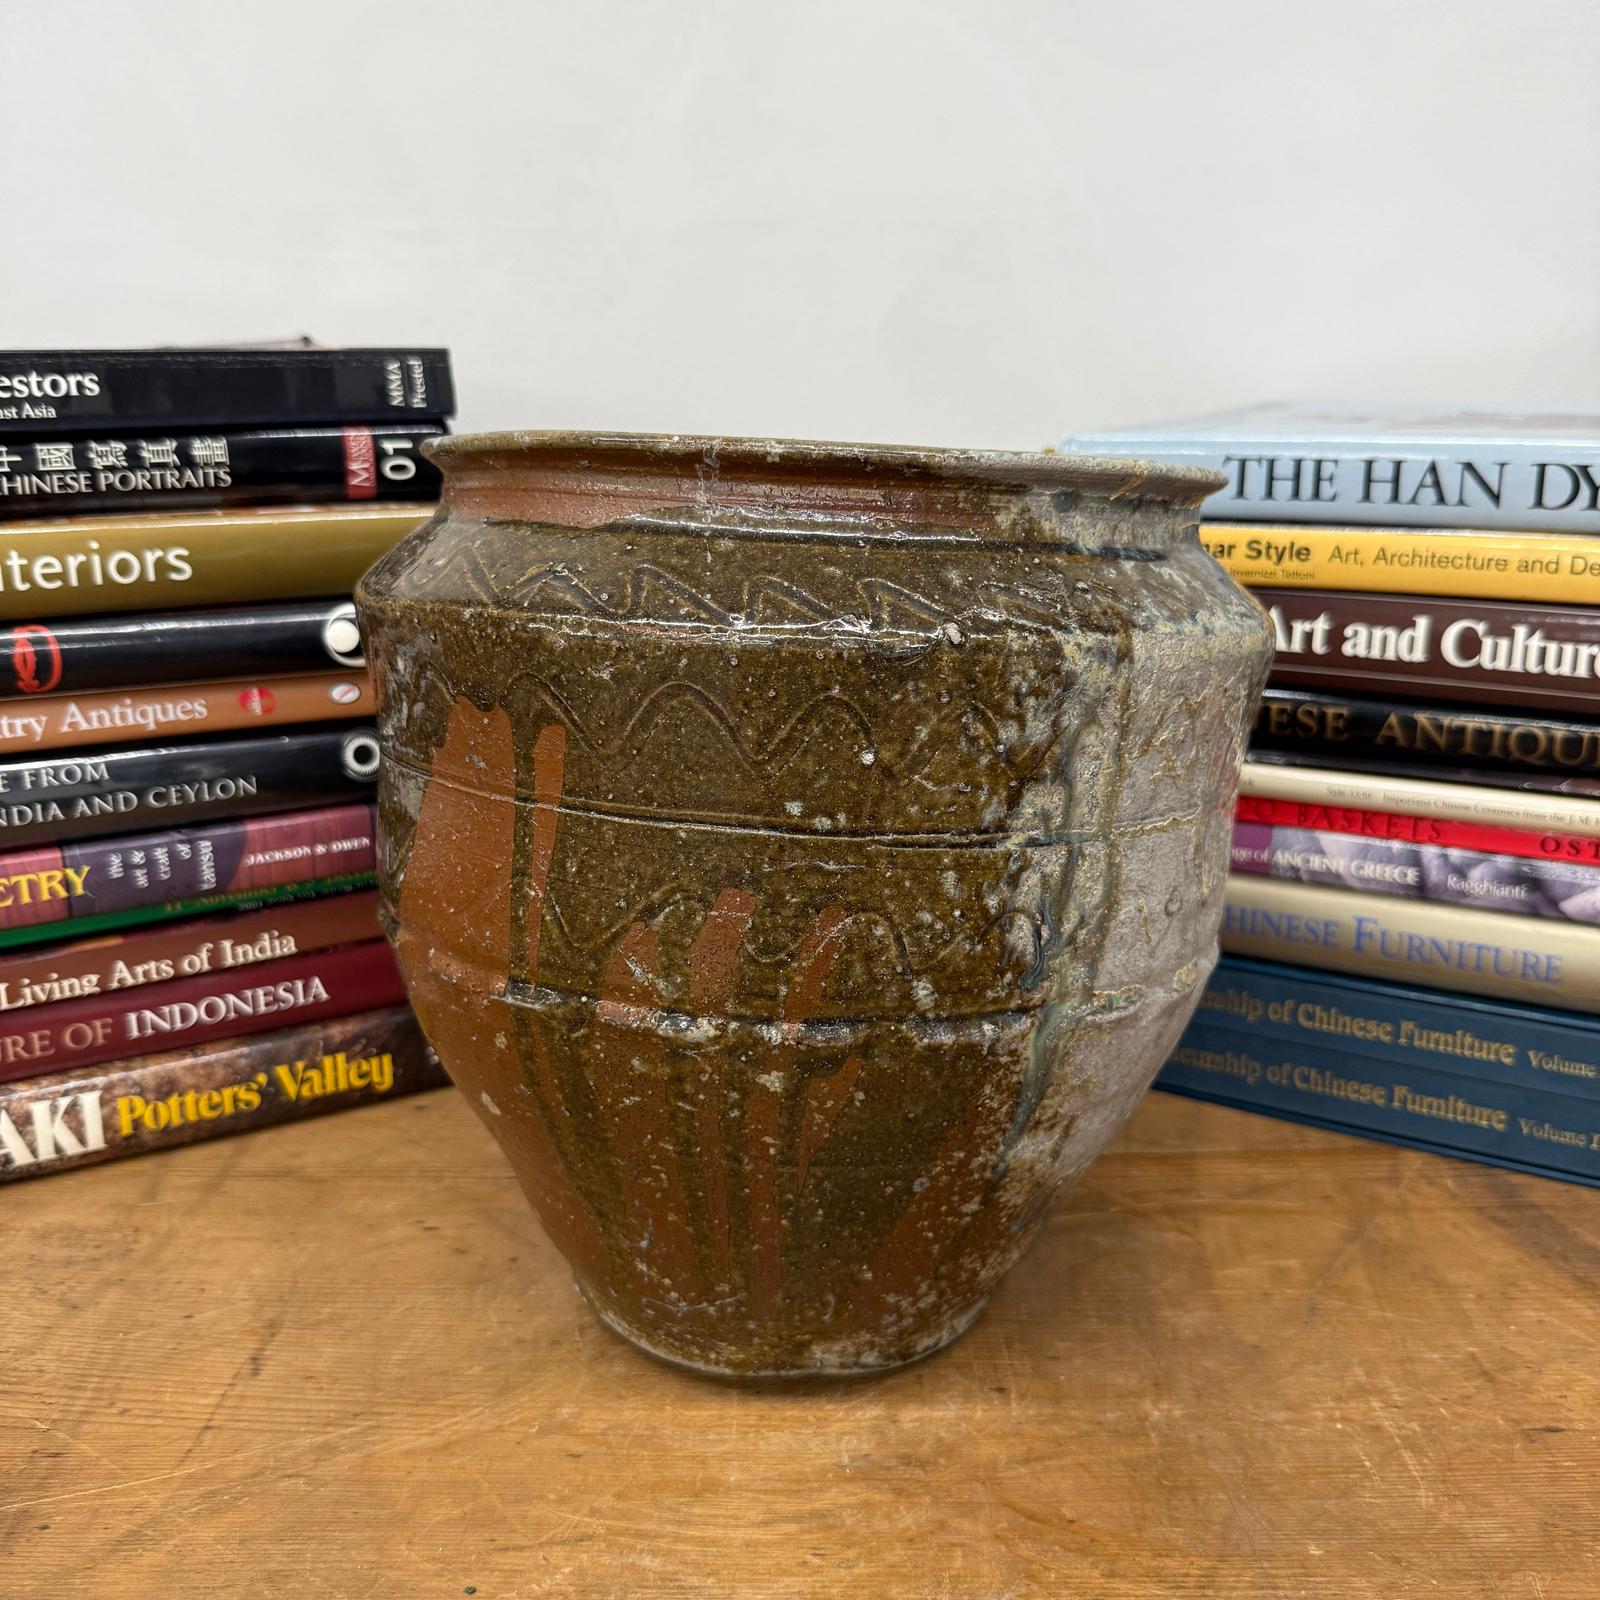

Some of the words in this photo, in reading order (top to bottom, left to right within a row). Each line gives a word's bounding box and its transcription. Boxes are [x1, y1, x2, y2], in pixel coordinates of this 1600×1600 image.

[21, 401, 57, 419] Asia
[0, 471, 93, 495] HINESE
[97, 463, 232, 492] PORTRAITS
[379, 438, 416, 480] 01
[1223, 453, 1338, 503] THE
[1361, 459, 1508, 509] HAN
[0, 540, 193, 592] teriors
[1245, 539, 1312, 566] Style
[1328, 545, 1364, 566] Art,
[1373, 547, 1508, 572] Architecture
[1517, 555, 1559, 575] and
[1270, 606, 1331, 655] Art
[1341, 614, 1432, 663] and
[1440, 618, 1600, 679] Cultur
[60, 698, 208, 732] Antiques
[22, 762, 109, 791] FROM
[73, 791, 138, 819] AND
[147, 775, 257, 808] CEYLON
[1297, 803, 1441, 841] BASKETS
[246, 846, 311, 867] JACKSON
[329, 837, 371, 853] OWEN
[1272, 849, 1345, 873] ANCIENT
[1350, 859, 1420, 886] GREECE
[107, 960, 175, 991] Arts
[182, 943, 213, 973] of
[218, 931, 299, 967] India
[64, 1018, 113, 1050] OF
[125, 975, 331, 1040] INDONESIA
[1267, 998, 1296, 1024] of
[1297, 1002, 1395, 1044] Chinese
[1398, 1019, 1517, 1066] Furniture
[1527, 1050, 1597, 1078] Volume
[275, 1052, 394, 1101] Valley
[1266, 1061, 1295, 1086] of
[1293, 1066, 1387, 1107] Chinese
[1391, 1084, 1508, 1132] Furniture
[1518, 1117, 1586, 1147] Volume
